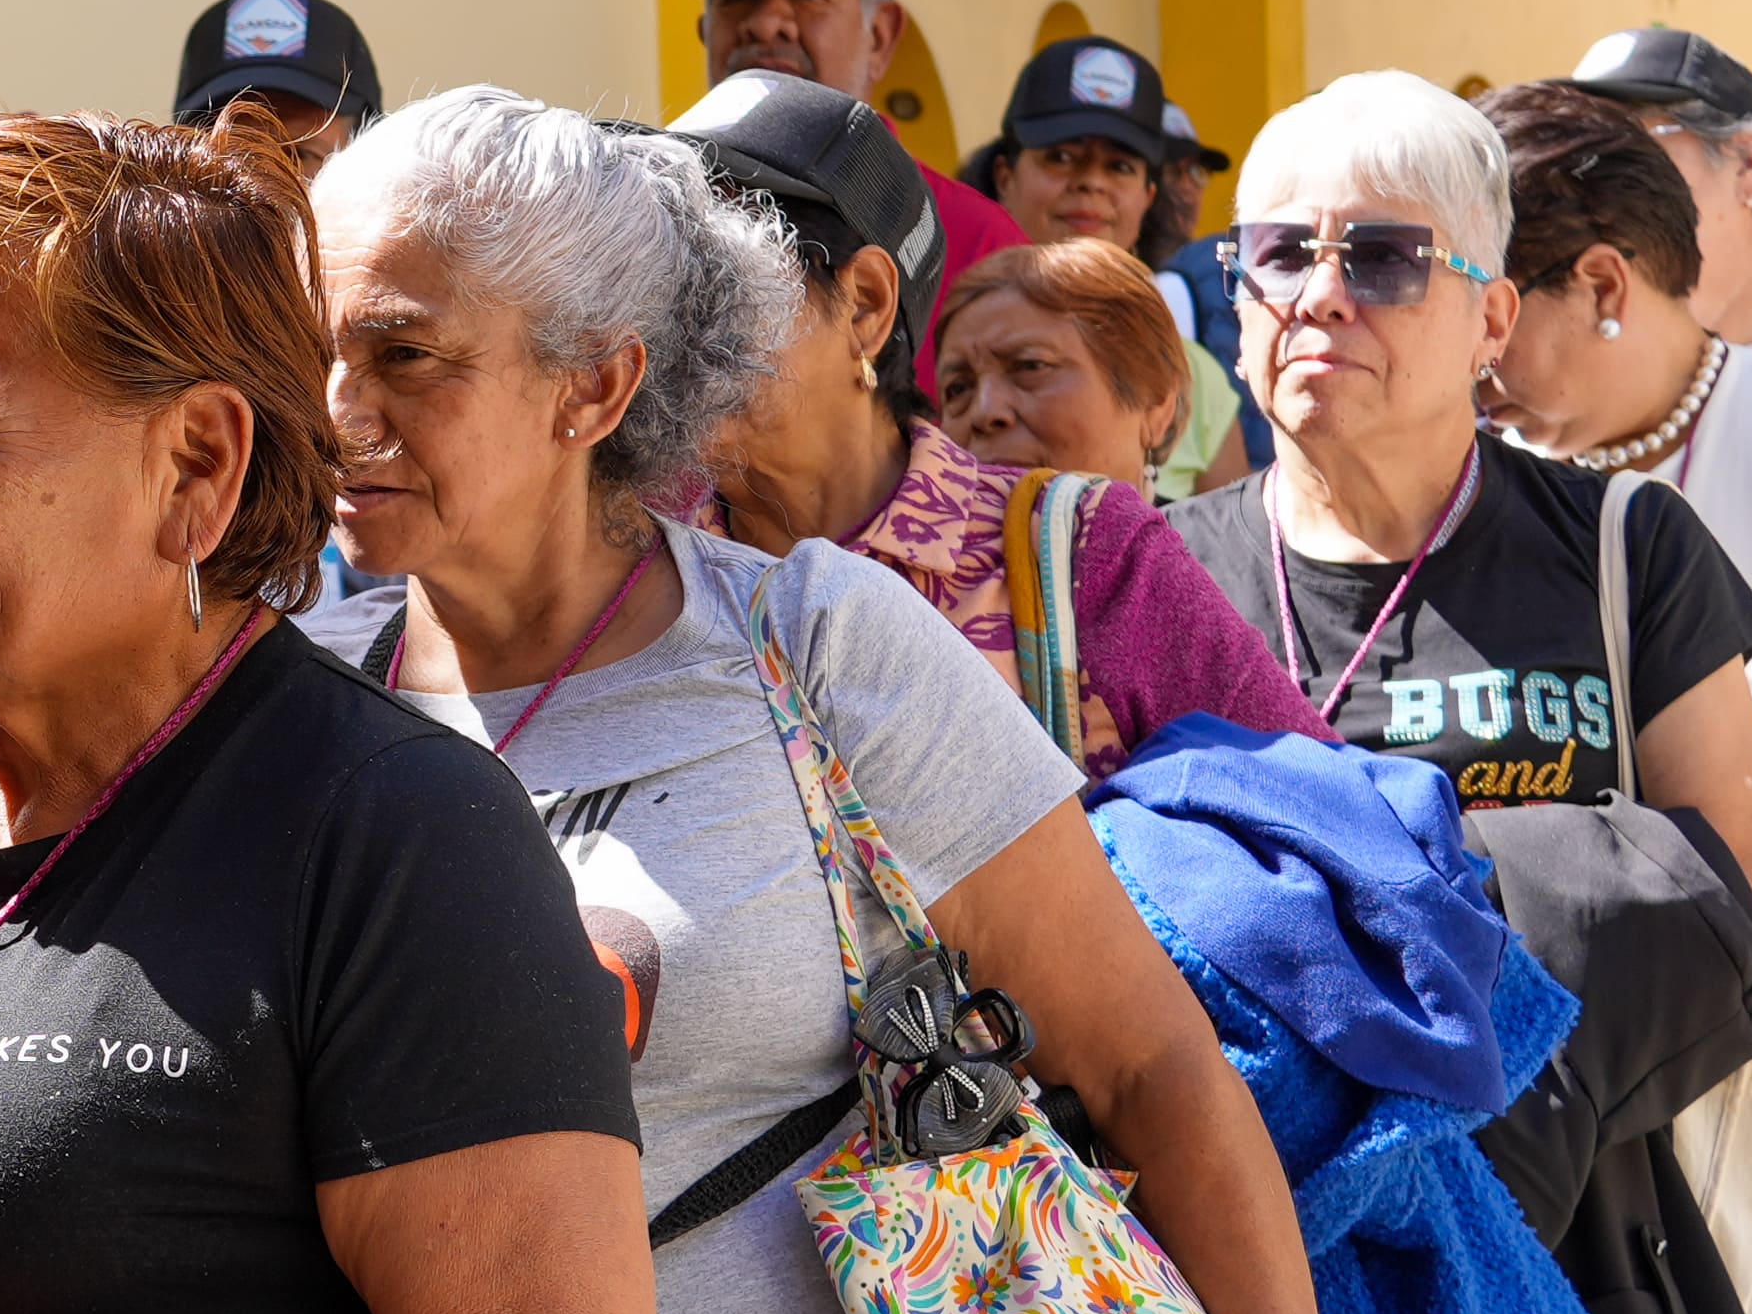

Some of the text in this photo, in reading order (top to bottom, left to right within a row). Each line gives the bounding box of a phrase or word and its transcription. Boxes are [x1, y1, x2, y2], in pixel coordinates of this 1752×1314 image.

[1382, 668, 1611, 751] BUGS
[1457, 737, 1578, 798] and
[99, 1038, 189, 1078] YOU
